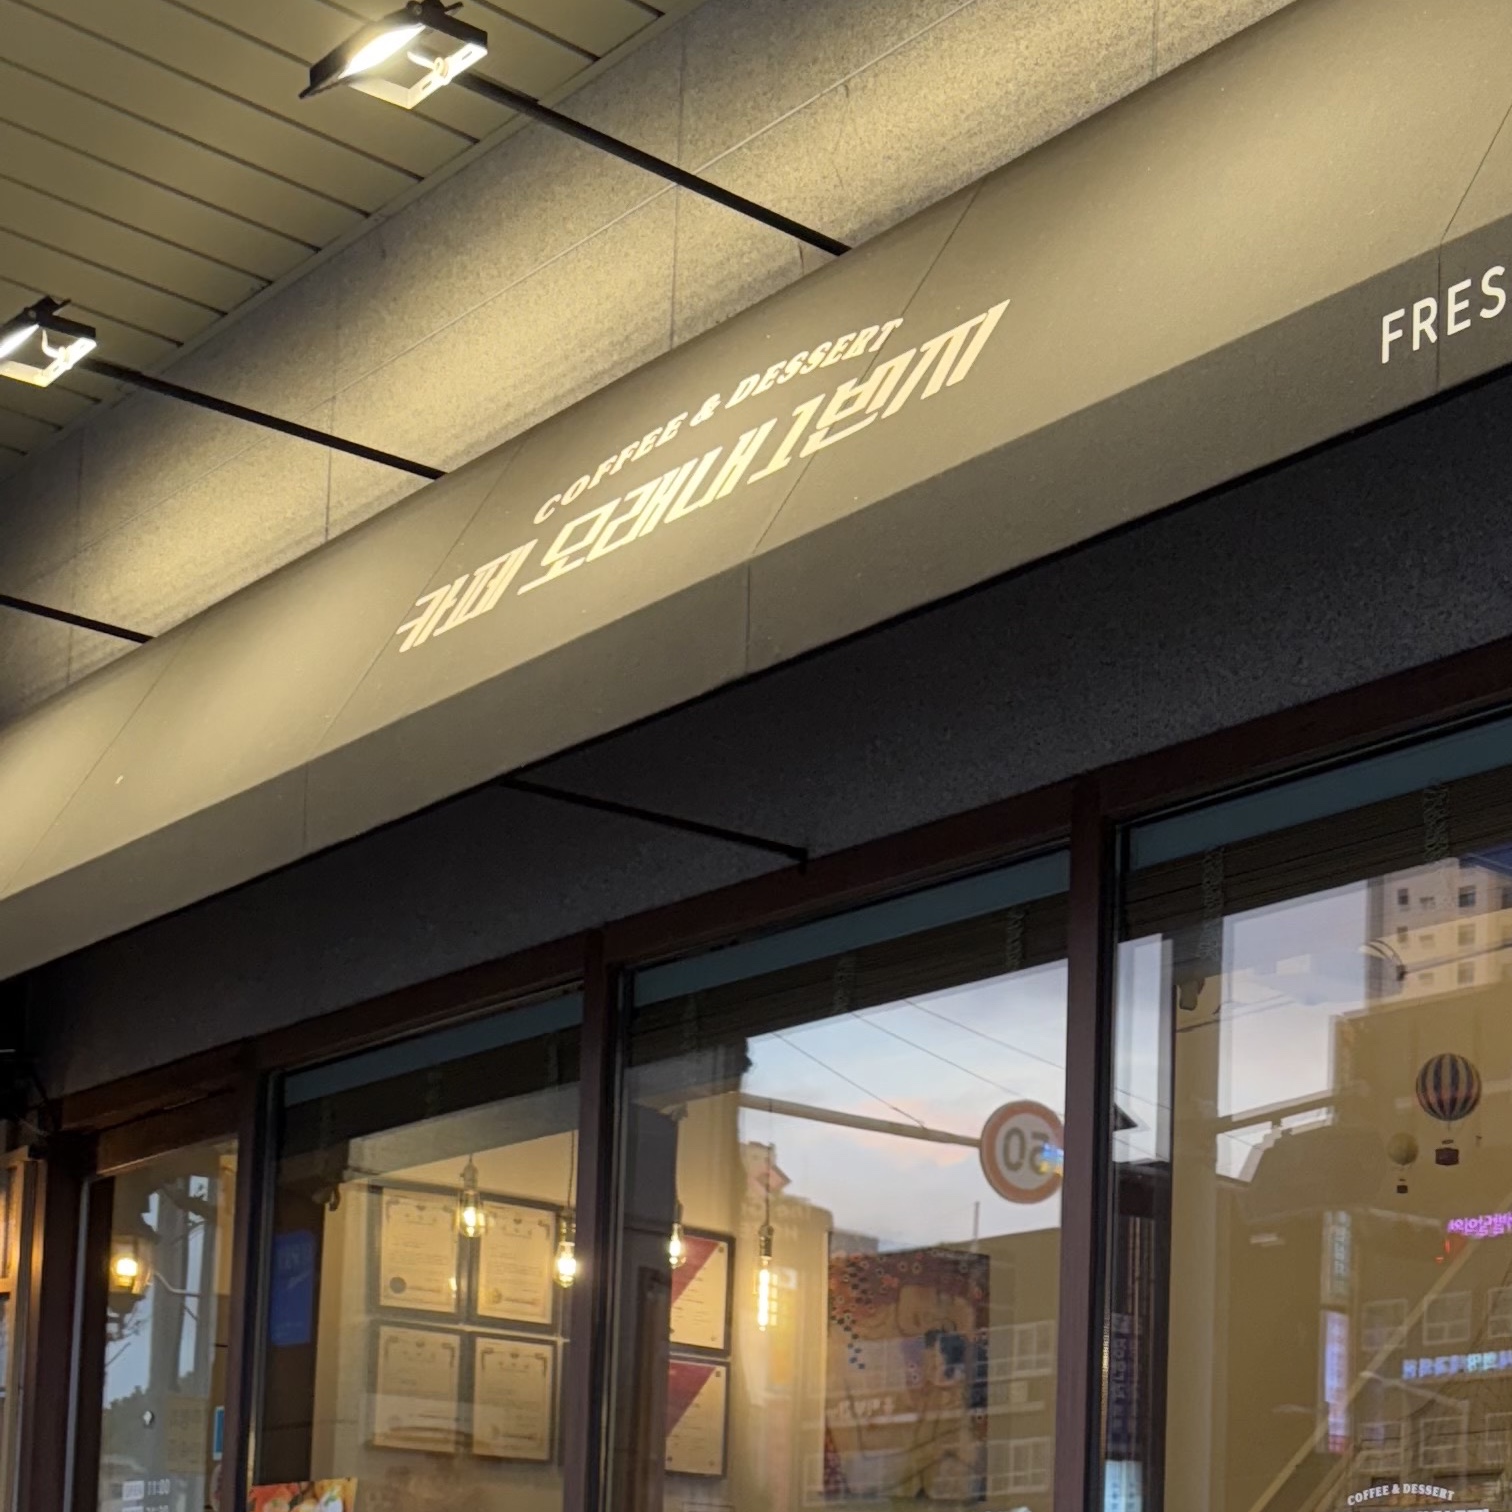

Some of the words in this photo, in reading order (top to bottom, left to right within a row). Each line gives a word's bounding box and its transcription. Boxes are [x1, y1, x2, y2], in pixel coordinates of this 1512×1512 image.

[533, 412, 688, 524] COFFEE
[690, 393, 721, 427] &
[724, 318, 904, 409] DESSERT
[398, 538, 538, 653] 카페
[1347, 1484, 1390, 1506] COFFEE
[1392, 1483, 1400, 1495] &
[1403, 1483, 1455, 1501] DESSERT
